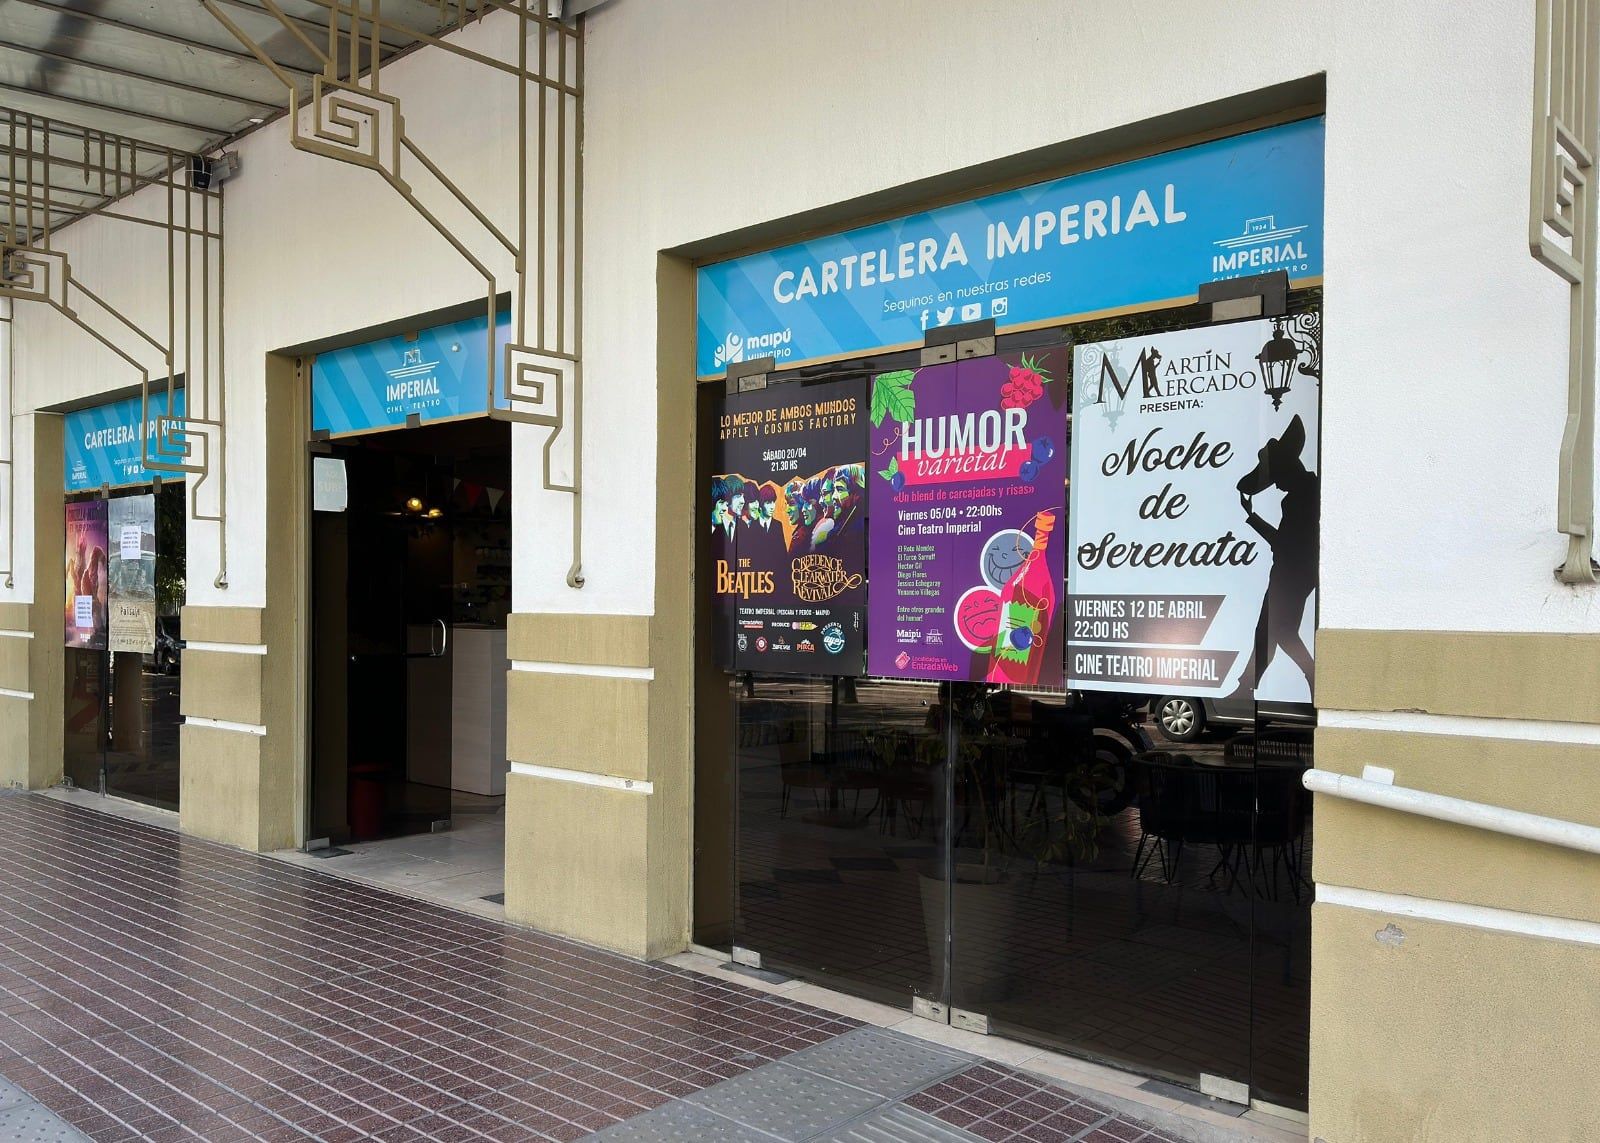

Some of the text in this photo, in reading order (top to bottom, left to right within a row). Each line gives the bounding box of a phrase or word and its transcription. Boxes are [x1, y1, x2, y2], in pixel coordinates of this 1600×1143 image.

[773, 183, 1187, 304] CARTELERA IMPERIAL
[1213, 240, 1308, 273] IMPERIAL
[883, 271, 1052, 314] Seguinos en nuestras redes
[386, 376, 440, 402] IMPERIAL
[386, 405, 403, 413] CINE
[413, 398, 440, 409] TEATRO
[720, 398, 856, 428] LO MEJOR DE AMBOS MUNDOS
[1139, 399, 1204, 414] PRESENTA:
[84, 423, 135, 450] CARTELERA
[720, 413, 857, 440] APPLE Y COSMOS FACTORY
[901, 407, 1028, 461] HUMOR
[762, 447, 807, 461] SÁBADO 20/04
[917, 448, 1007, 477] varietal
[1101, 427, 1234, 477] Noche
[771, 460, 798, 472] 21.30 HS
[911, 491, 934, 502] blend
[936, 489, 947, 500] de
[949, 486, 996, 500] carcajadas
[998, 487, 1004, 498] y
[1138, 482, 1190, 520] de
[898, 505, 1003, 521] Viernes 05/04 22:00hs
[897, 521, 982, 536] Cine Teatro Imperial
[1077, 530, 1259, 571] Serenata
[738, 558, 751, 568] THE
[791, 554, 843, 573] CREEDENCE
[716, 559, 775, 600] BEATLES
[791, 570, 848, 583] CLEARWATER
[793, 580, 838, 601] REVIVAL
[1074, 599, 1207, 619] VIERNES 12 DE ABRIL
[896, 629, 922, 640] Maipú
[1074, 620, 1129, 639] 22:00 HS
[911, 661, 959, 672] EntradaWeb
[1075, 653, 1220, 681] CINE TEATRO IMPERIAL
